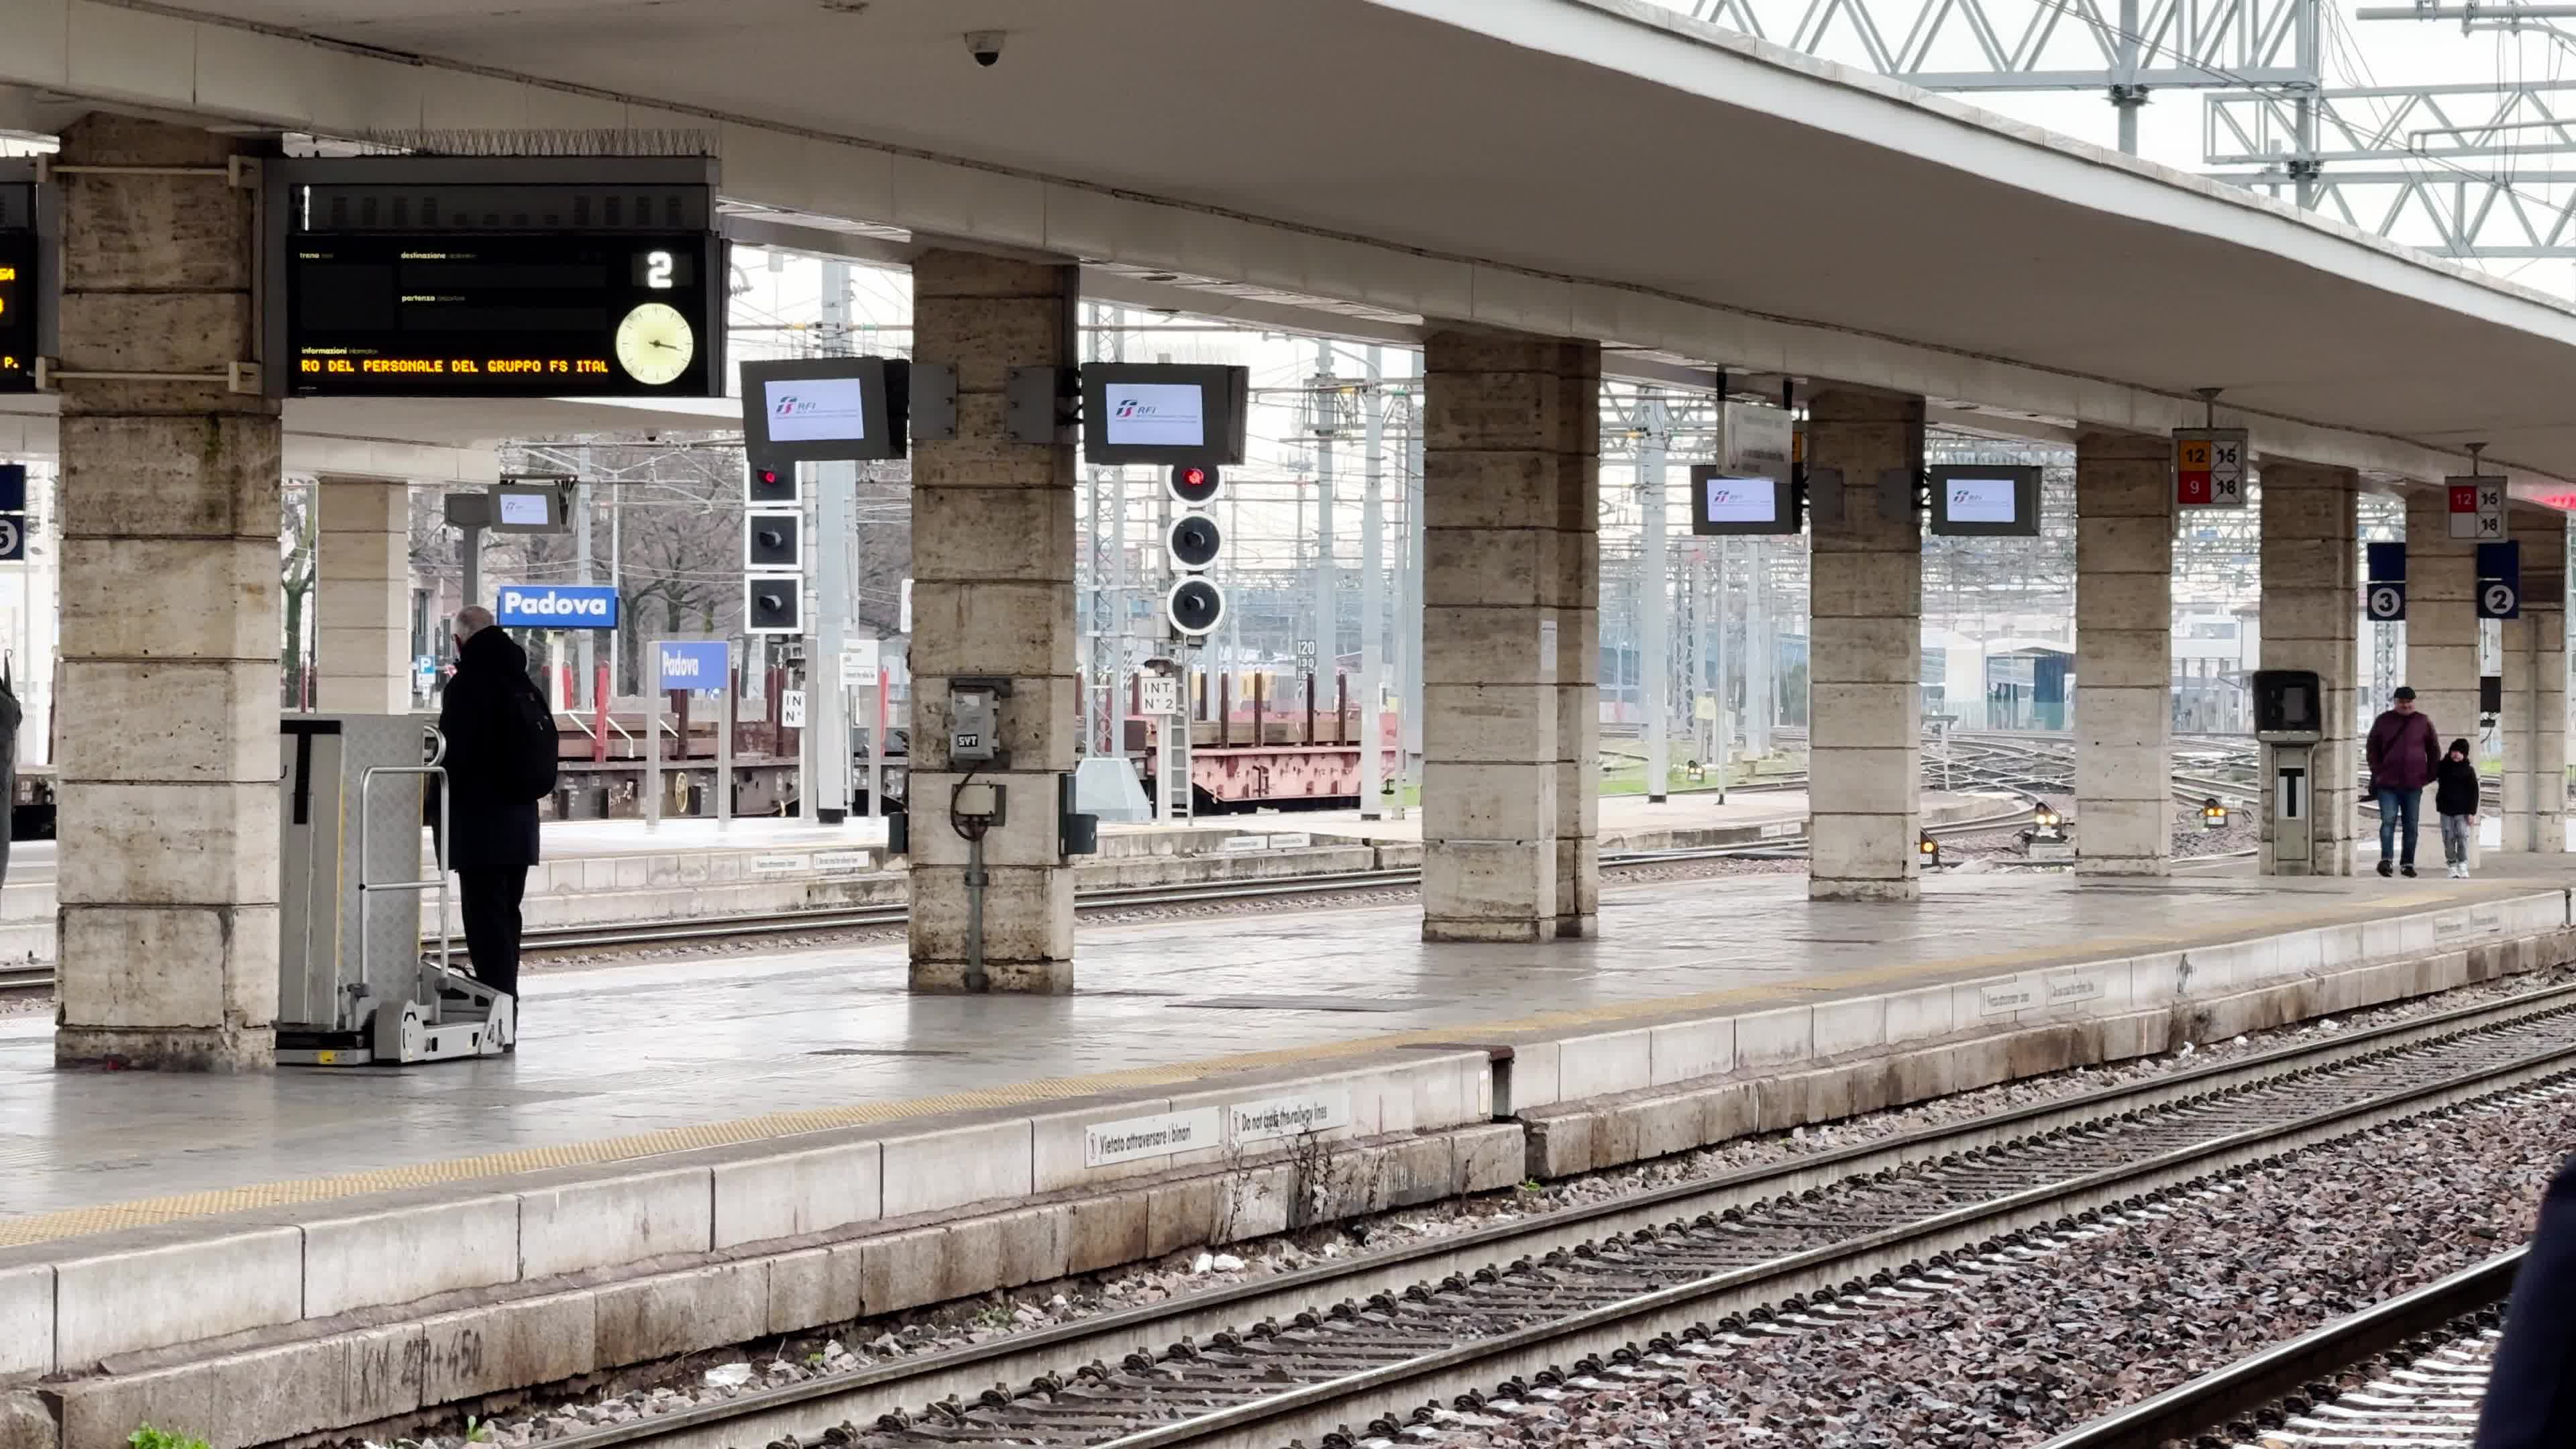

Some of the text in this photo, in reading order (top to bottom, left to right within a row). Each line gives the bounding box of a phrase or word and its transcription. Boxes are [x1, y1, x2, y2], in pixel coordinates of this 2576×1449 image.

[400, 251, 445, 259] destinazione
[647, 251, 674, 288] 2
[402, 294, 435, 303] partenza
[301, 346, 347, 354] informazioni
[301, 359, 608, 373] RO DEL PERSONALE DEL GRUPPO FS ITAL
[1137, 406, 1157, 414] RFI
[2186, 448, 2237, 463] 12 15
[2189, 480, 2200, 494] 9
[2455, 493, 2471, 505] 12
[504, 591, 607, 616] Padova
[2378, 592, 2394, 612] 3
[2491, 590, 2508, 609] 2
[1297, 641, 1315, 655] 120
[420, 657, 432, 673] P
[661, 649, 699, 677] Padova
[1298, 658, 1314, 667] 130
[1165, 698, 1174, 709] 2
[2278, 767, 2305, 817] T
[1242, 1113, 1250, 1132] Do
[1252, 1112, 1263, 1130] not
[1099, 1135, 1124, 1155] Vietato
[1126, 1130, 1167, 1151] attraversare
